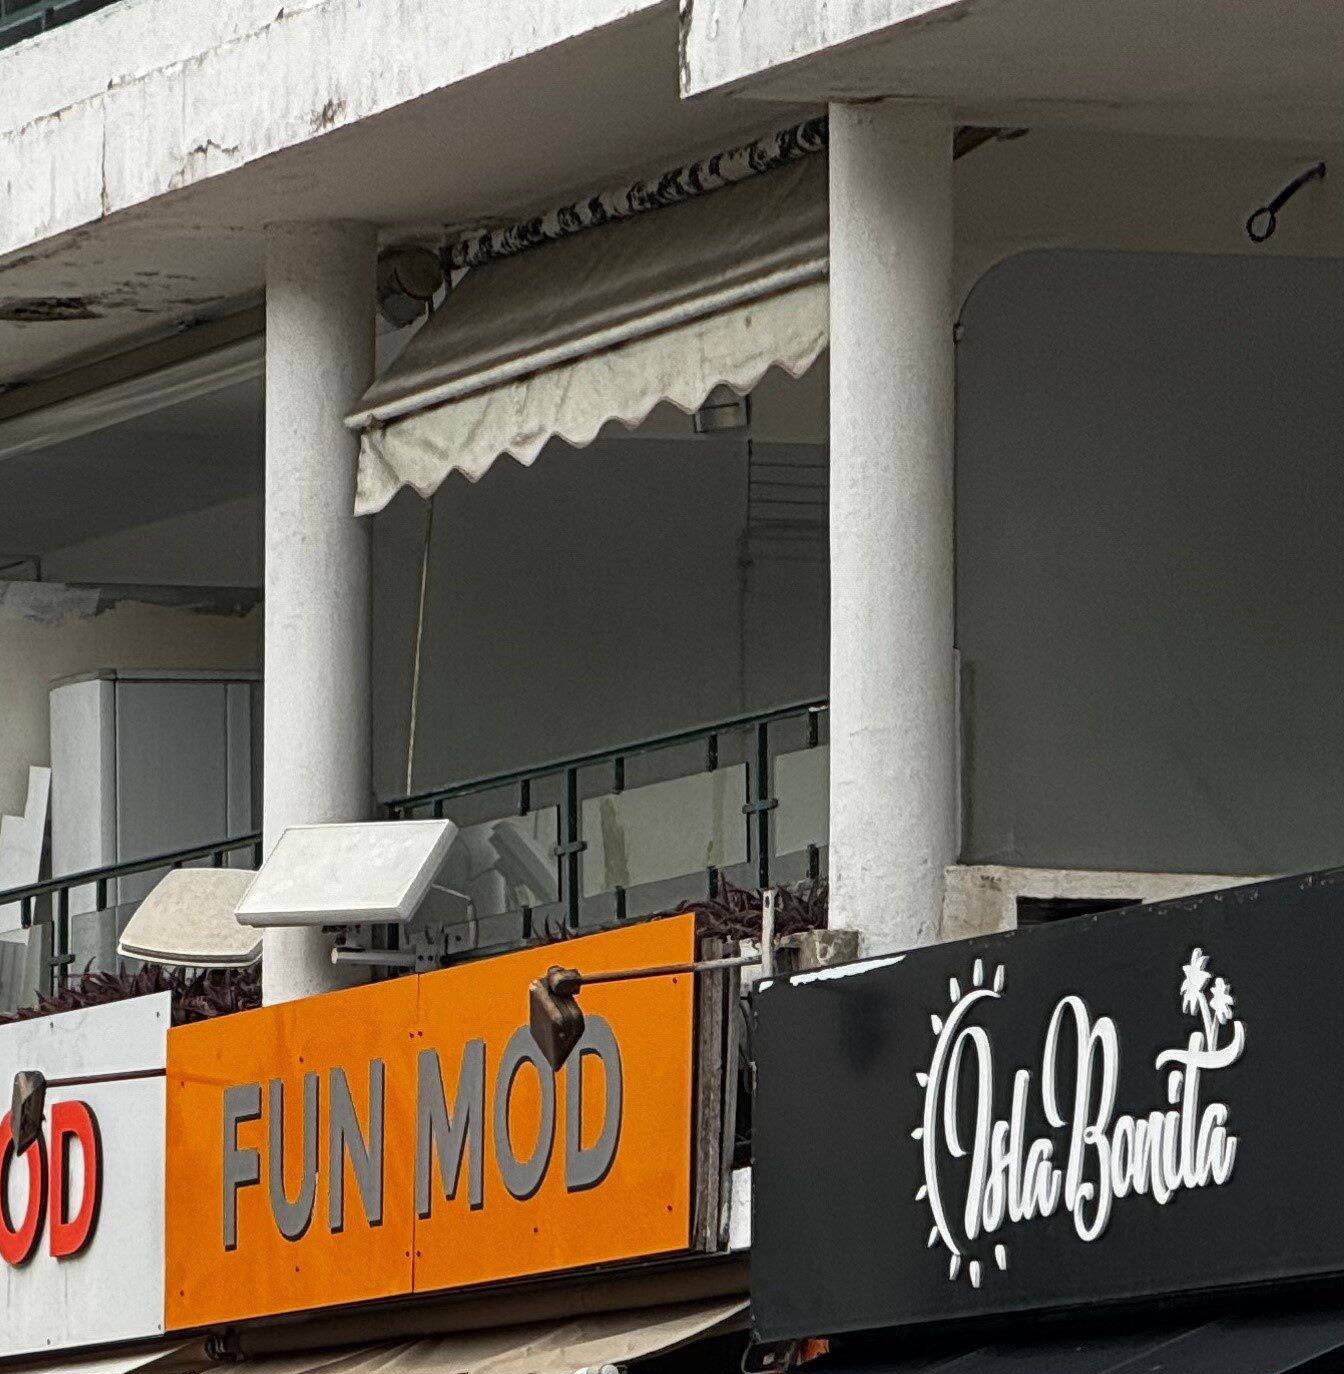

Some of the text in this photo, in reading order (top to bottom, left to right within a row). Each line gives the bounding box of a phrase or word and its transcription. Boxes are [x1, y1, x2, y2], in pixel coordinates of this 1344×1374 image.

[223, 1015, 623, 1250] FUN MOD
[944, 996, 1245, 1242] Isla Bonita
